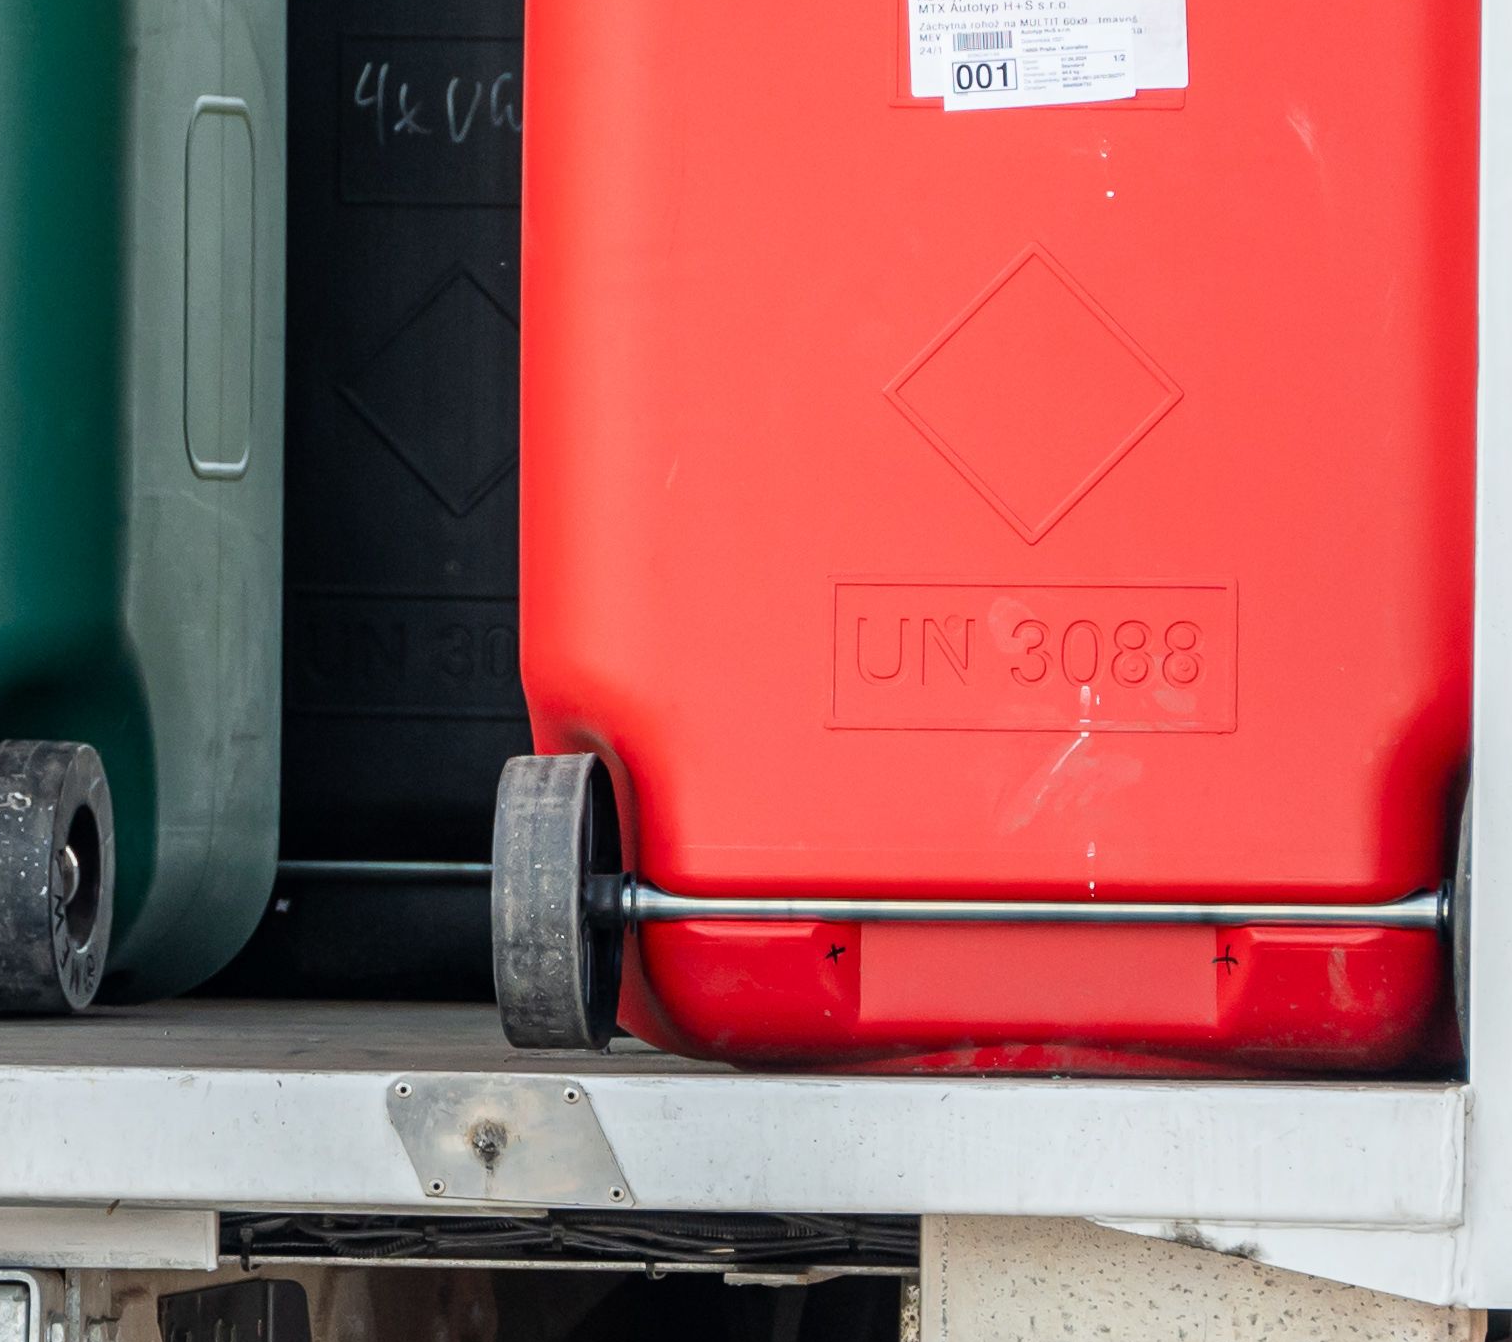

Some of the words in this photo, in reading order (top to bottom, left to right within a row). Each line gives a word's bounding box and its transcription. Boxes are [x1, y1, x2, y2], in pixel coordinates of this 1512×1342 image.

[918, 4, 945, 14] MTX
[950, 2, 999, 14] Autotyp
[956, 62, 1008, 90] 001
[856, 616, 976, 687] UN
[1009, 618, 1206, 689] 3088
